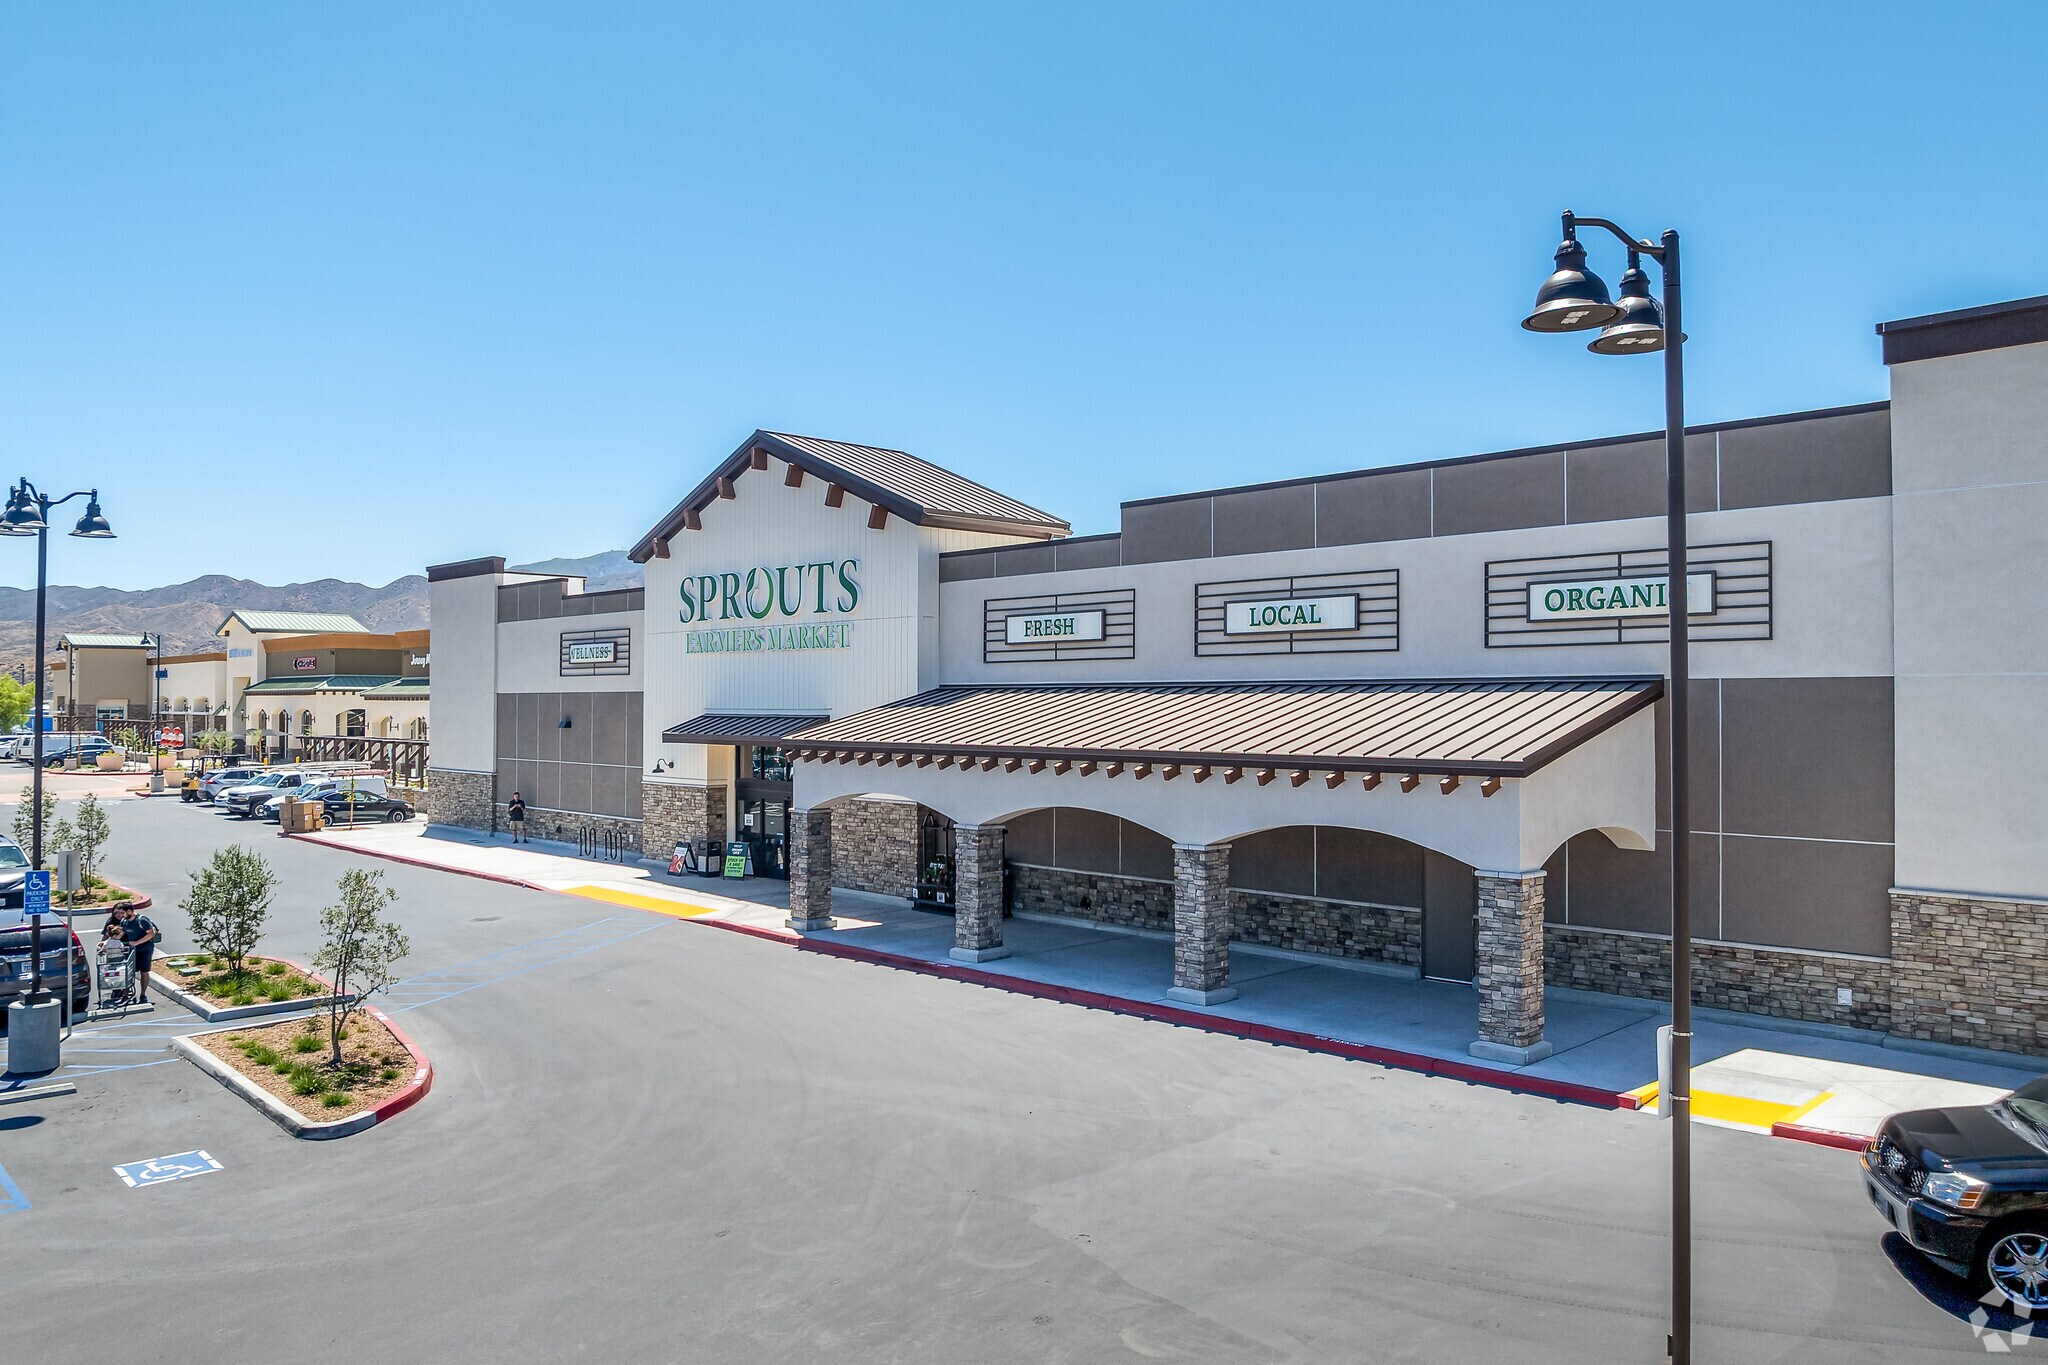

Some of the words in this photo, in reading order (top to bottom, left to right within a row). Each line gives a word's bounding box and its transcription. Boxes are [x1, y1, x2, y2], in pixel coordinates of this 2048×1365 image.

[679, 558, 859, 624] SPROUTS
[1544, 583, 1668, 612] ORGANI
[1024, 618, 1074, 637] FRESH
[1249, 604, 1322, 626] LOCAL
[686, 627, 764, 654] FARMERS
[767, 624, 851, 650] MARKET
[570, 646, 609, 660] WELLNESS
